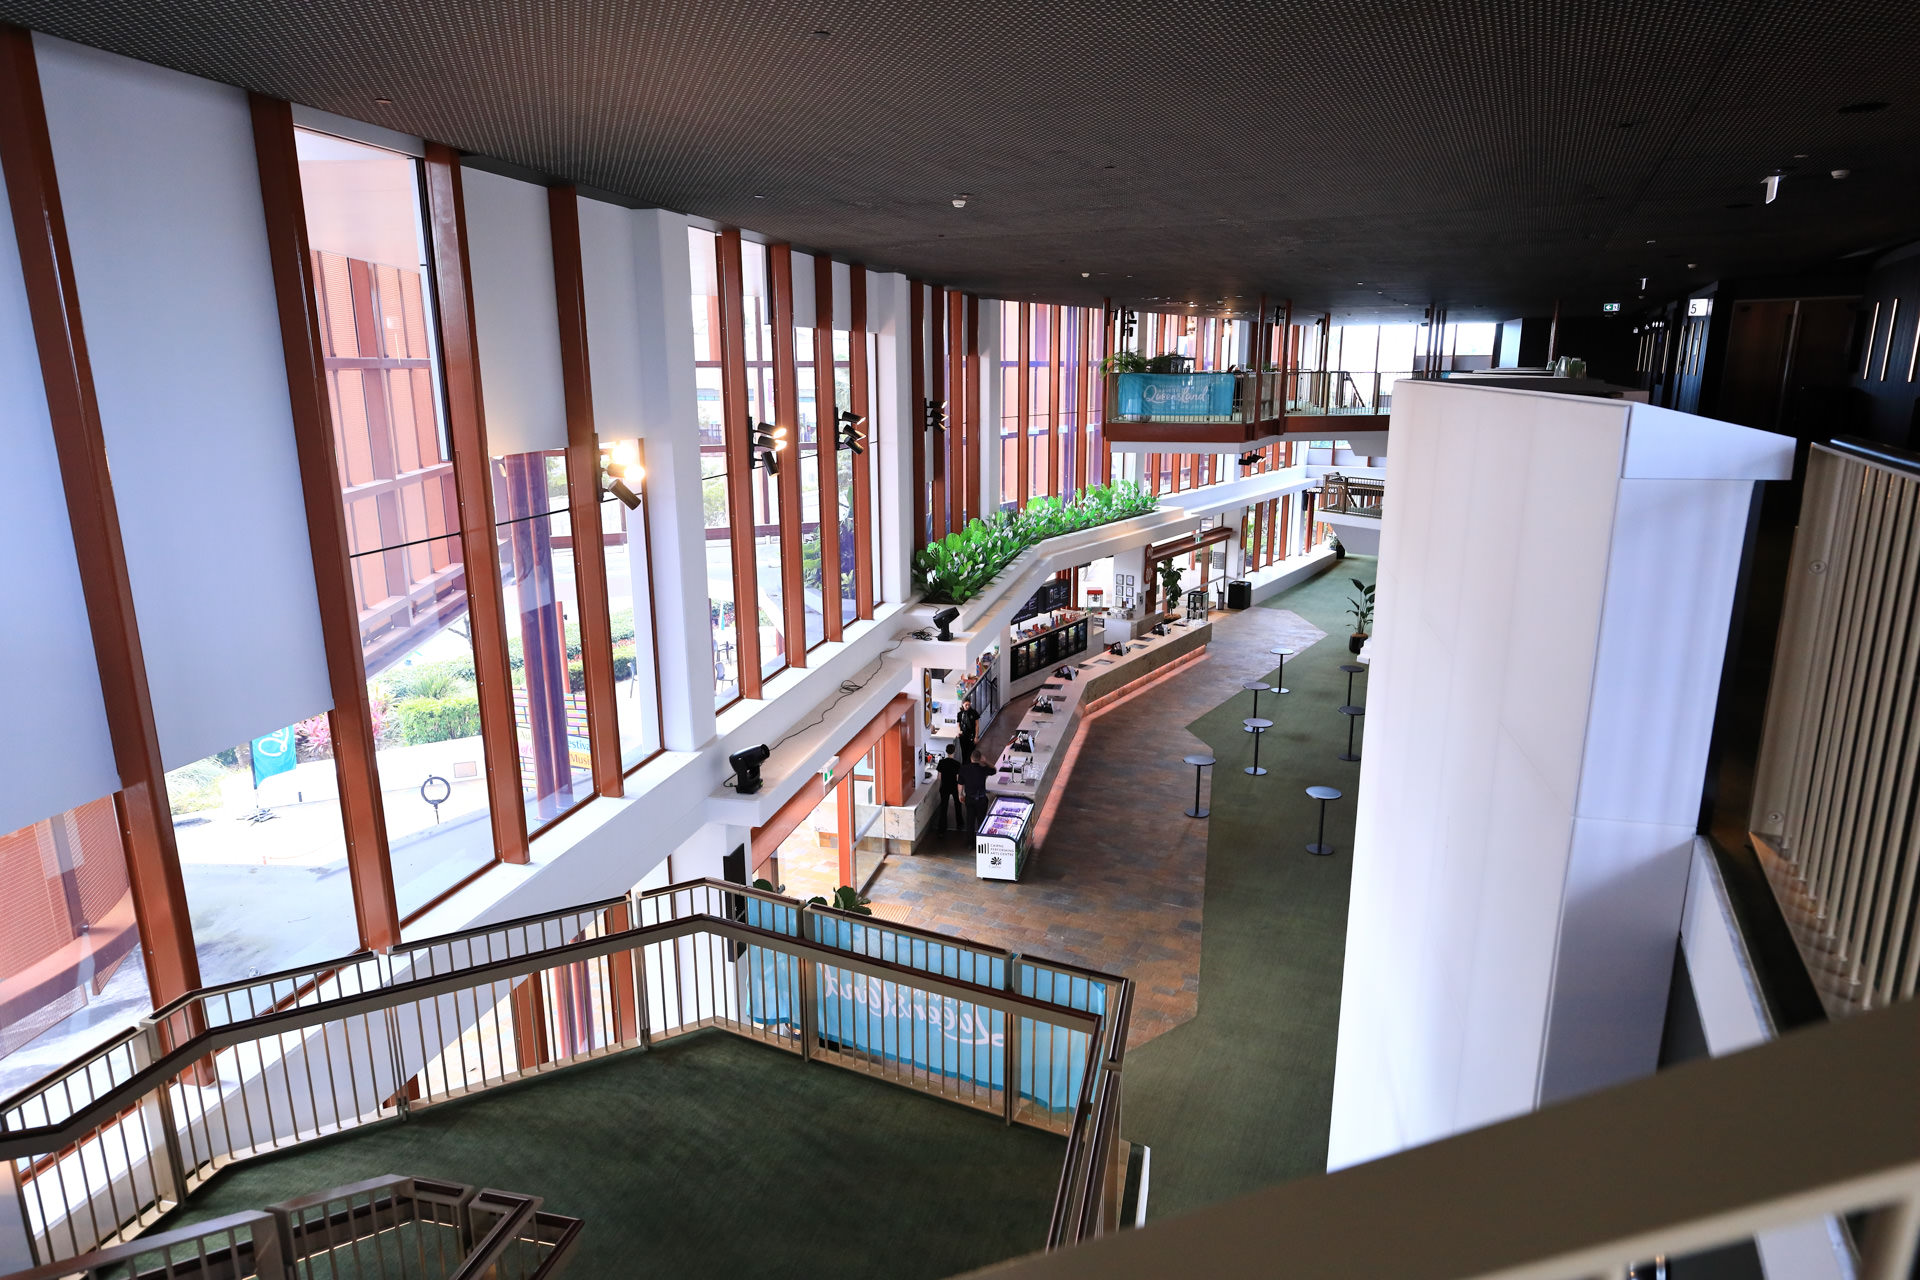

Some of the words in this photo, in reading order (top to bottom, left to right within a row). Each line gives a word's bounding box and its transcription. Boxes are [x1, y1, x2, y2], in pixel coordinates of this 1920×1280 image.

[1690, 304, 1697, 314] 5
[1143, 384, 1209, 404] Queensland
[569, 753, 591, 766] Musi
